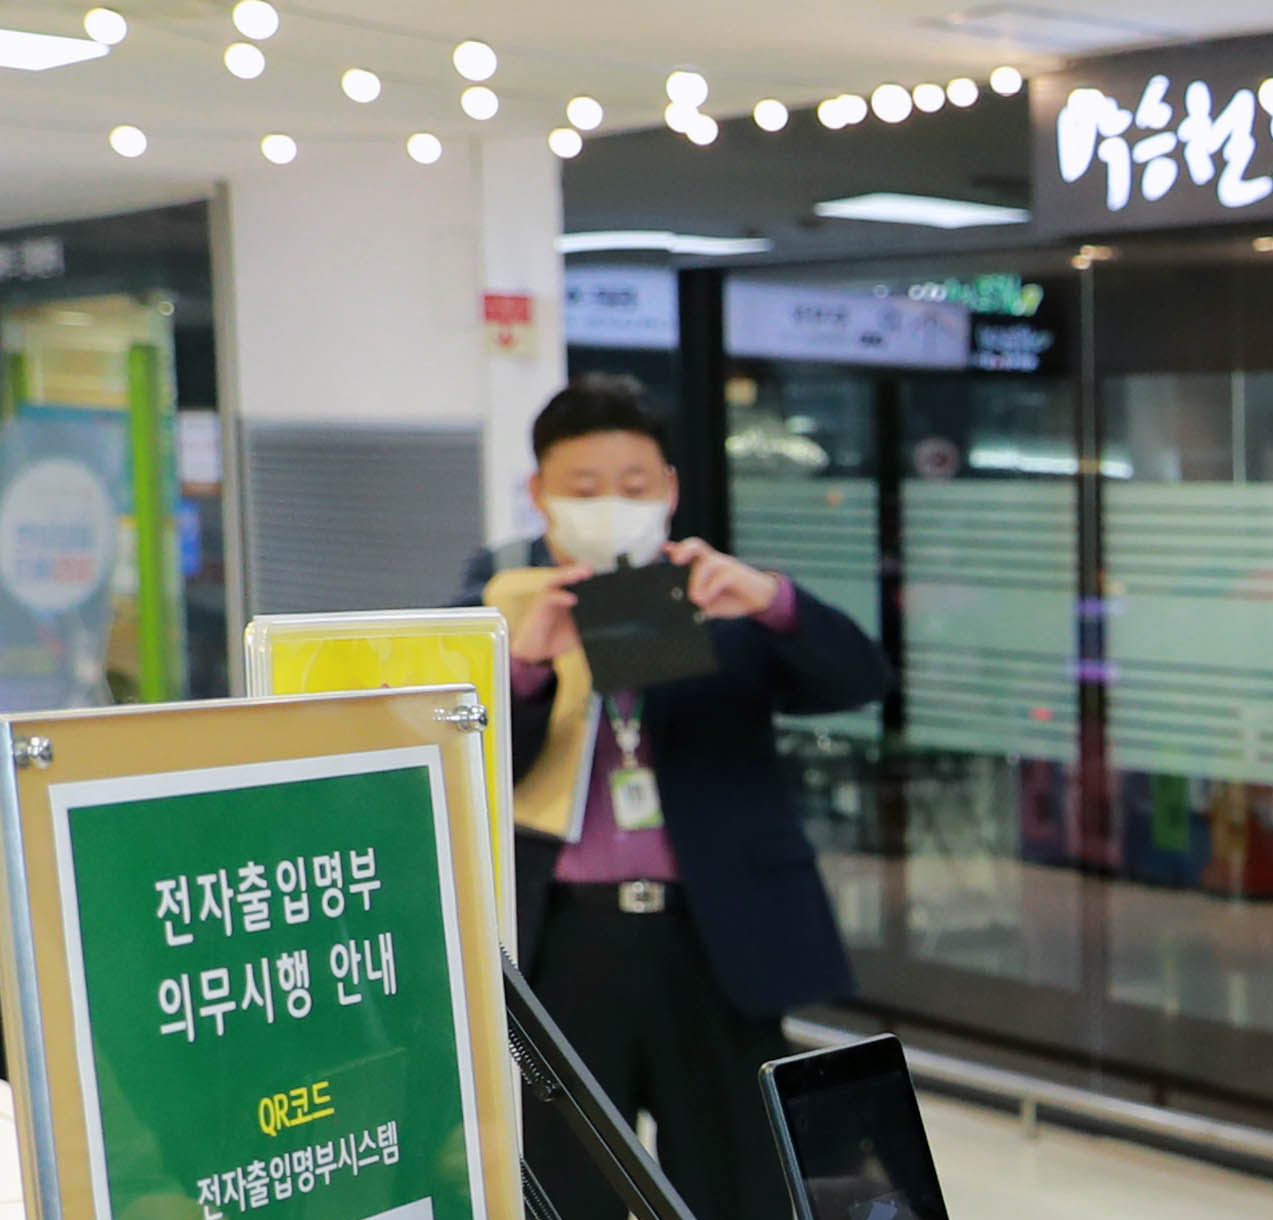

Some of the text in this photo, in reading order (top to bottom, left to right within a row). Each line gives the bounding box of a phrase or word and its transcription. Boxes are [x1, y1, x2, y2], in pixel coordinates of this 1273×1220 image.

[155, 847, 381, 946] 전자출입명부
[158, 932, 397, 1042] 의무시행 안내
[258, 1081, 335, 1136] QR코드
